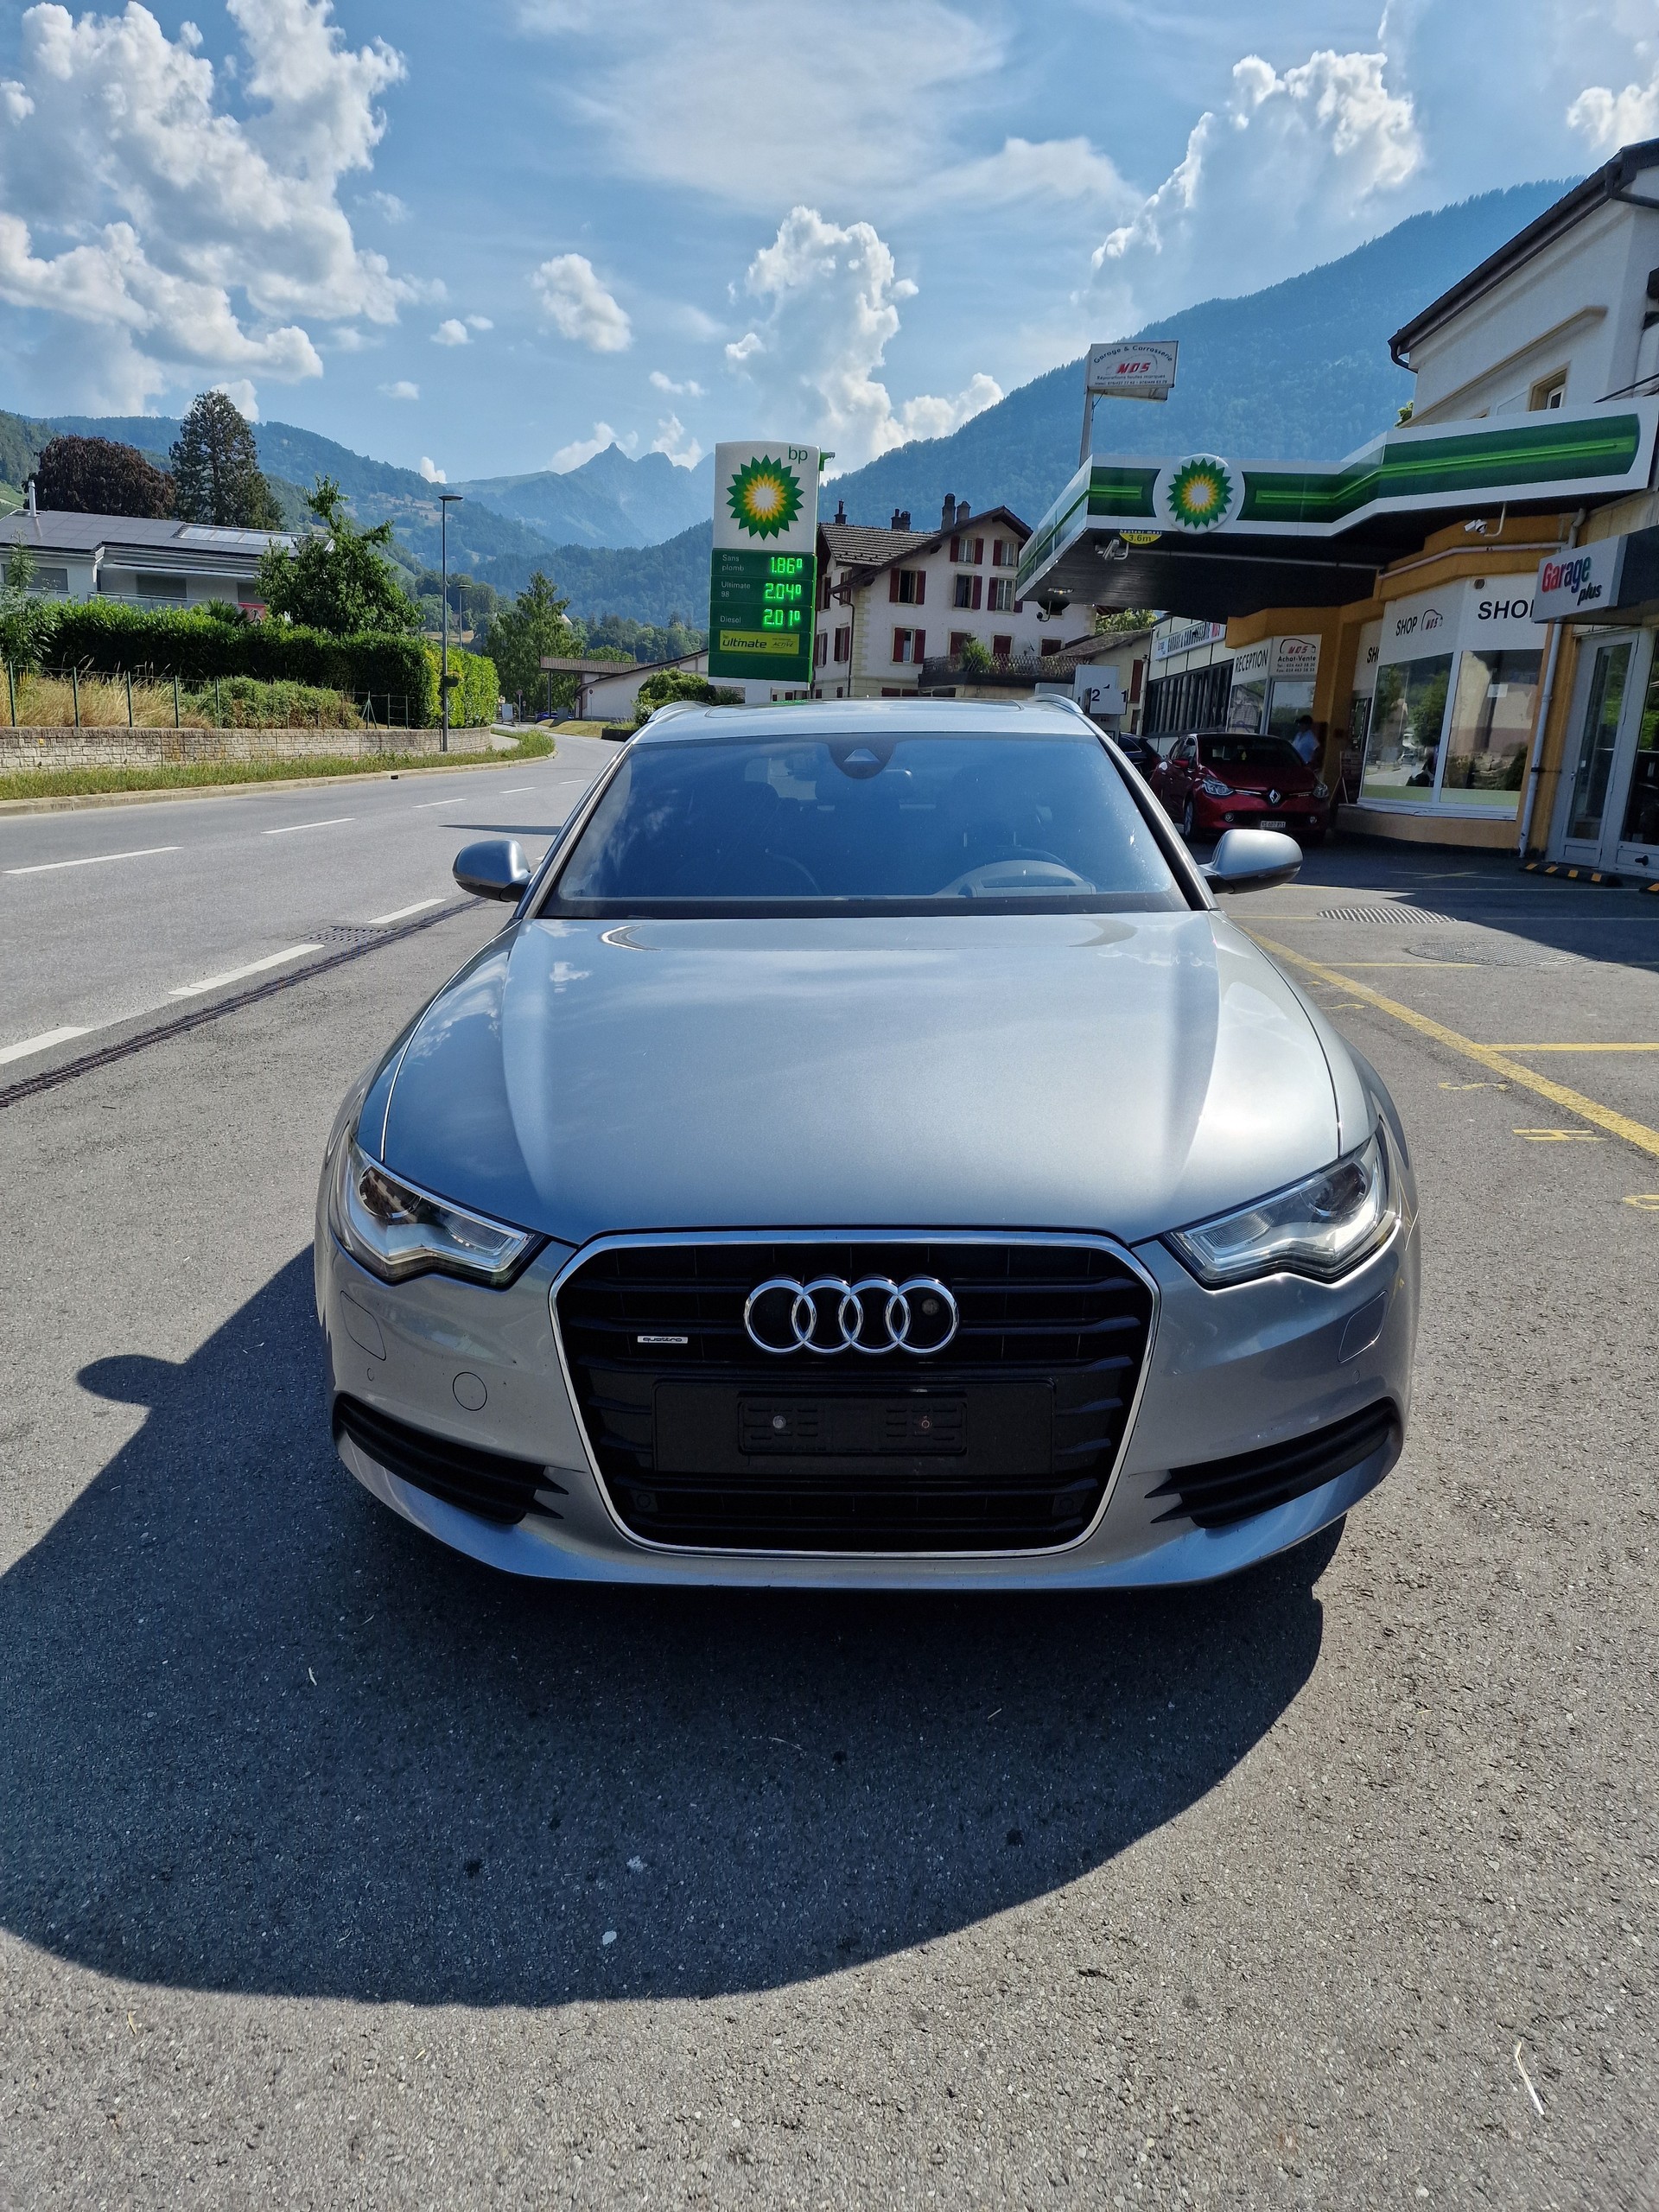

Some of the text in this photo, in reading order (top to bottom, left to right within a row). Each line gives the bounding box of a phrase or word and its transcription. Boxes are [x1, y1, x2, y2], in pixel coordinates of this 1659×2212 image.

[1093, 348, 1122, 364] Garage
[1132, 345, 1173, 362] Carrosserie
[788, 445, 808, 465] bp
[721, 563, 745, 572] plomb
[722, 554, 740, 563] Sans
[1541, 556, 1592, 594] Garage
[721, 581, 751, 589] Ultimate
[1577, 582, 1603, 607] plus
[1478, 599, 1535, 620] SHO
[720, 615, 741, 624] Diesel
[1395, 616, 1418, 637] SHOP
[722, 638, 767, 649] ultimate
[1235, 648, 1269, 673] RECEPTION
[1091, 689, 1128, 702] 2 1
